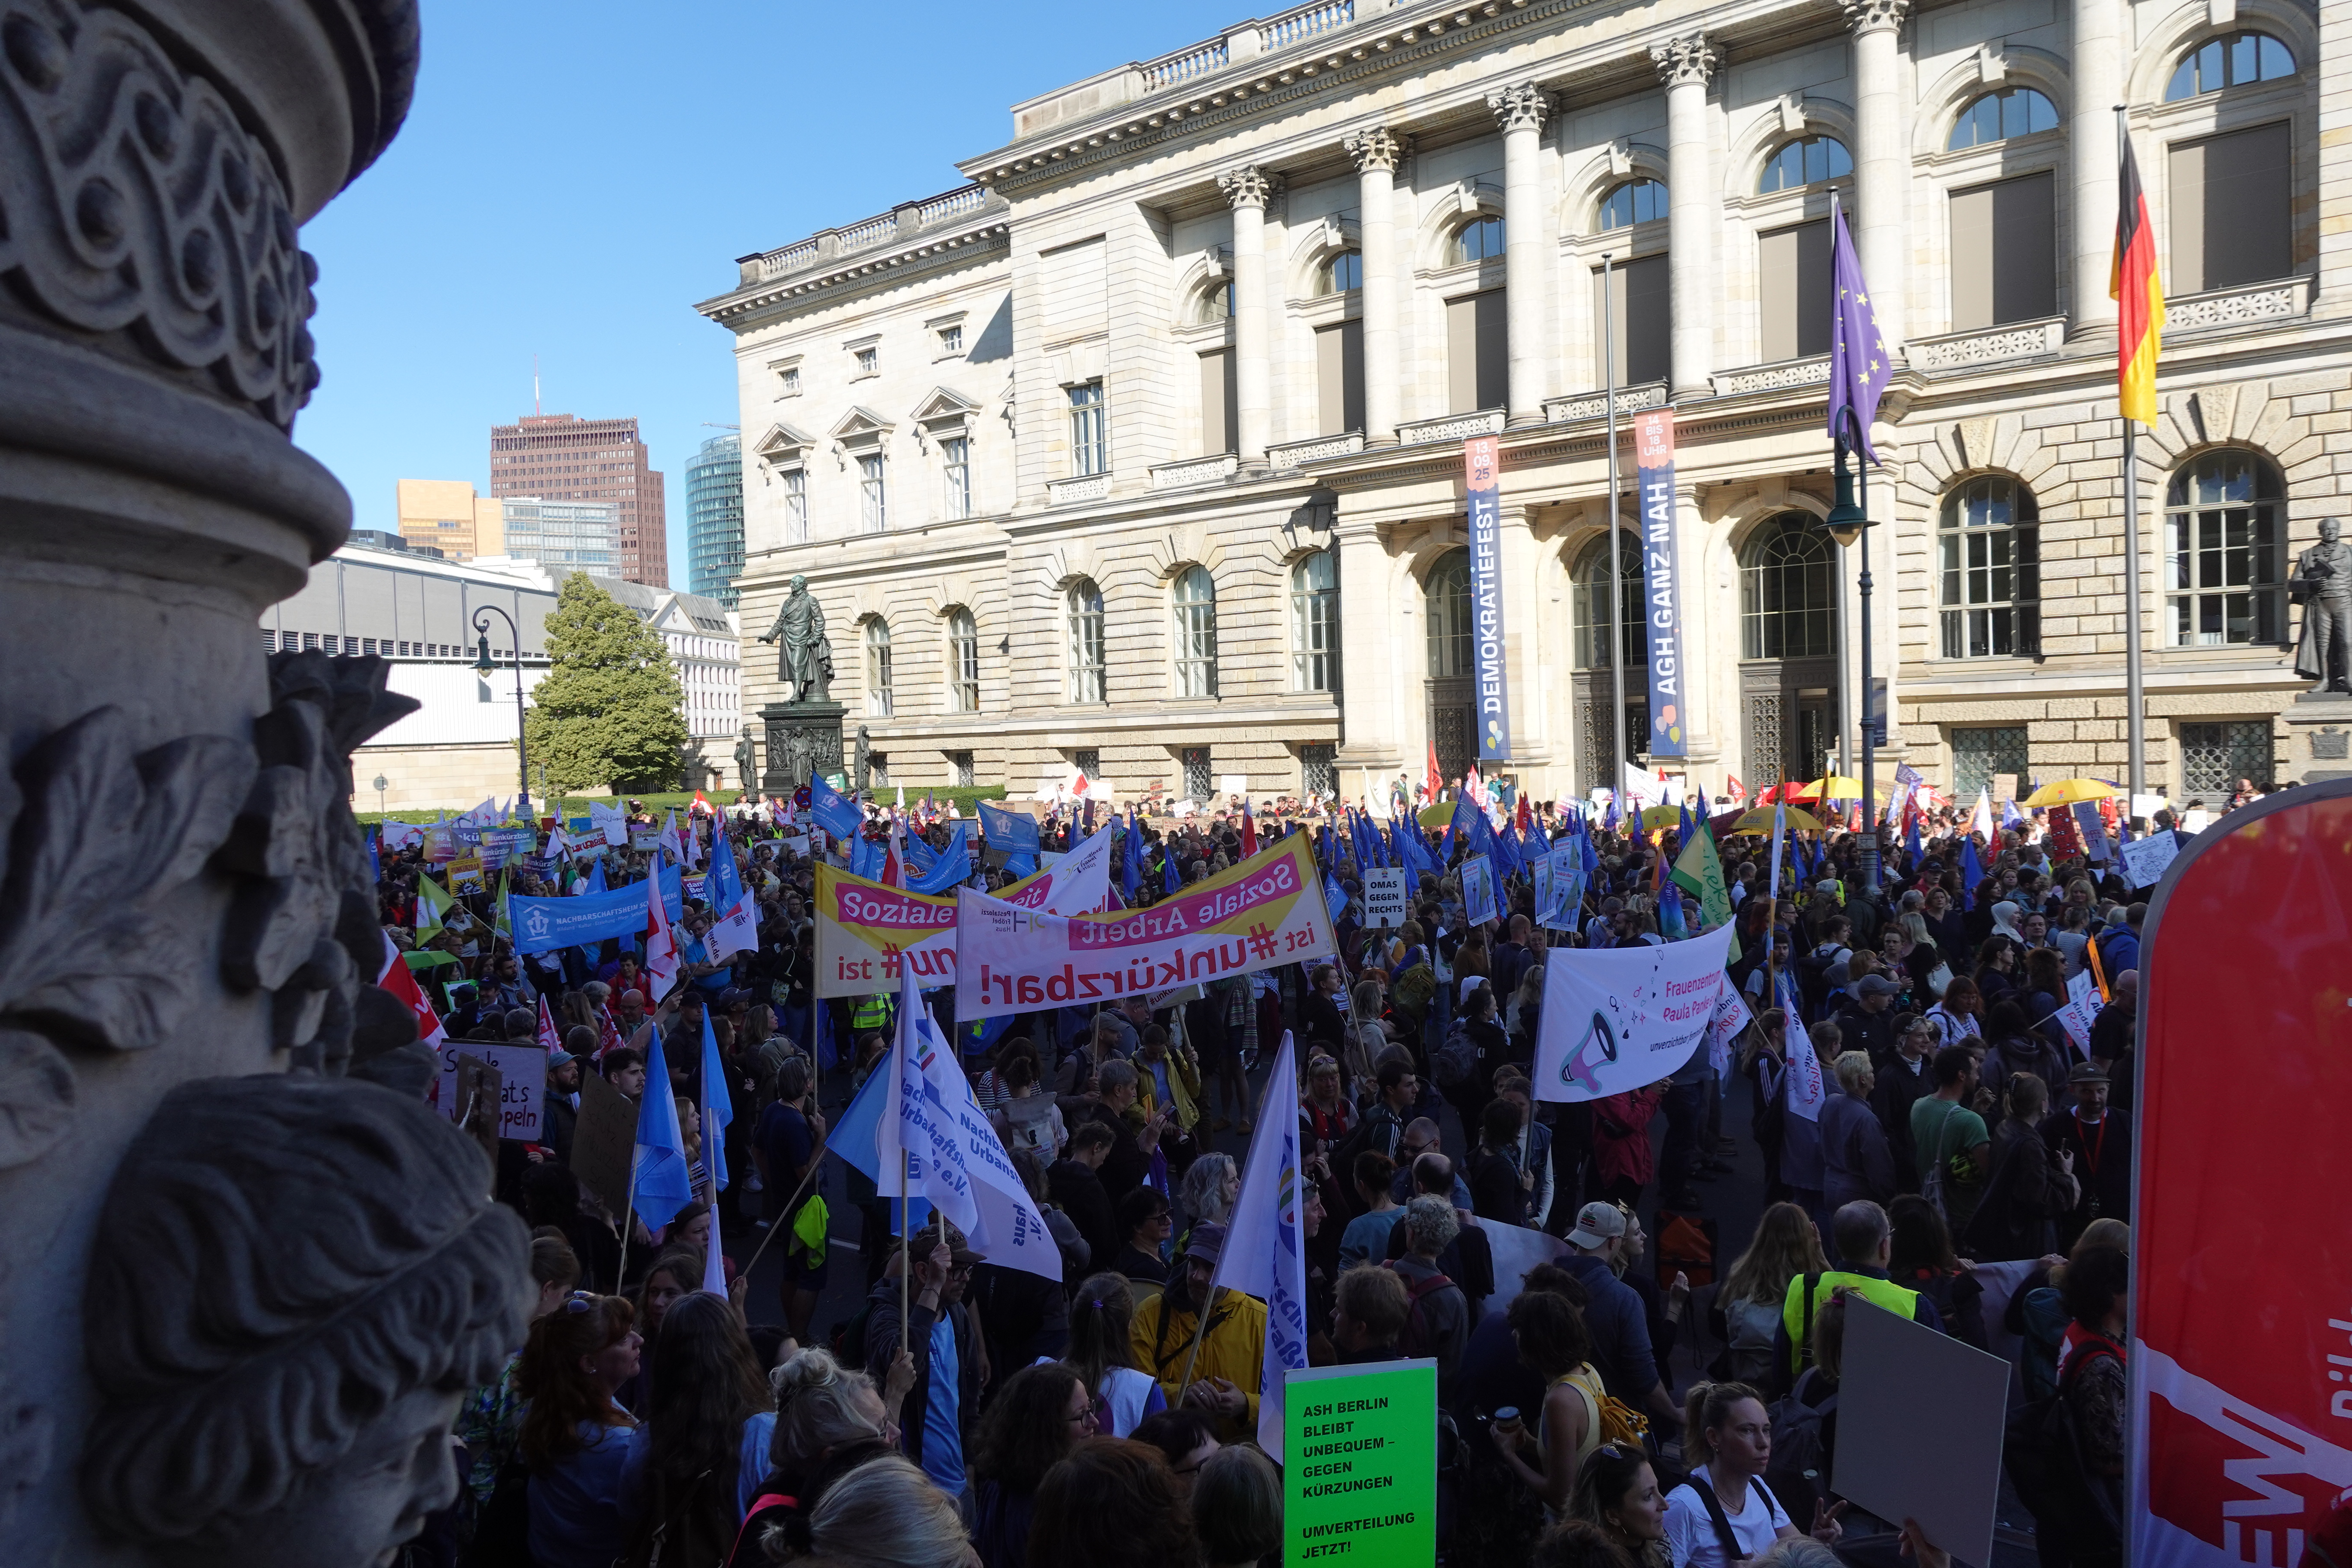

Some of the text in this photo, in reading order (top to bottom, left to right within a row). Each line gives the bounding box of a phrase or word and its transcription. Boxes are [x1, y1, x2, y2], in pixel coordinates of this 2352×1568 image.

[1647, 415, 1660, 425] 14
[1646, 425, 1664, 435] BIS
[1474, 441, 1492, 454] 13.
[1648, 435, 1660, 445] 18
[1644, 444, 1667, 456] UHR
[1473, 454, 1494, 468] 09.
[1475, 467, 1491, 481] 25
[1647, 483, 1677, 696] AGH GANZ NAH
[1475, 499, 1501, 714] DEMOKRATIEFEST
[487, 832, 530, 842] #unkürzbar
[1081, 855, 1097, 867] Fröbel
[1083, 862, 1096, 870] Haus
[1370, 881, 1398, 889] OMAS
[1369, 893, 1399, 901] GEGEN
[556, 904, 638, 925] NACHBARSCHAFTSHEIM
[843, 891, 954, 924] Soziale
[1369, 905, 1403, 913] RECHTS
[595, 918, 616, 926] Erziehung
[838, 956, 873, 980] ist
[1666, 969, 1721, 998] Frauenzentrum
[1663, 1002, 1690, 1023] Paula
[1650, 1034, 1689, 1052] unverzichtbar
[1303, 1396, 1389, 1418] ASH BERLIN
[1303, 1421, 1354, 1438] BLEIBT
[1303, 1437, 1384, 1458] UNBEQUEM
[1303, 1461, 1353, 1478] GEGEN
[1303, 1476, 1393, 1498] KÜRZUNGEN
[1302, 1512, 1415, 1539] UMVERTEILUNG
[1302, 1541, 1352, 1559] JETZT!
